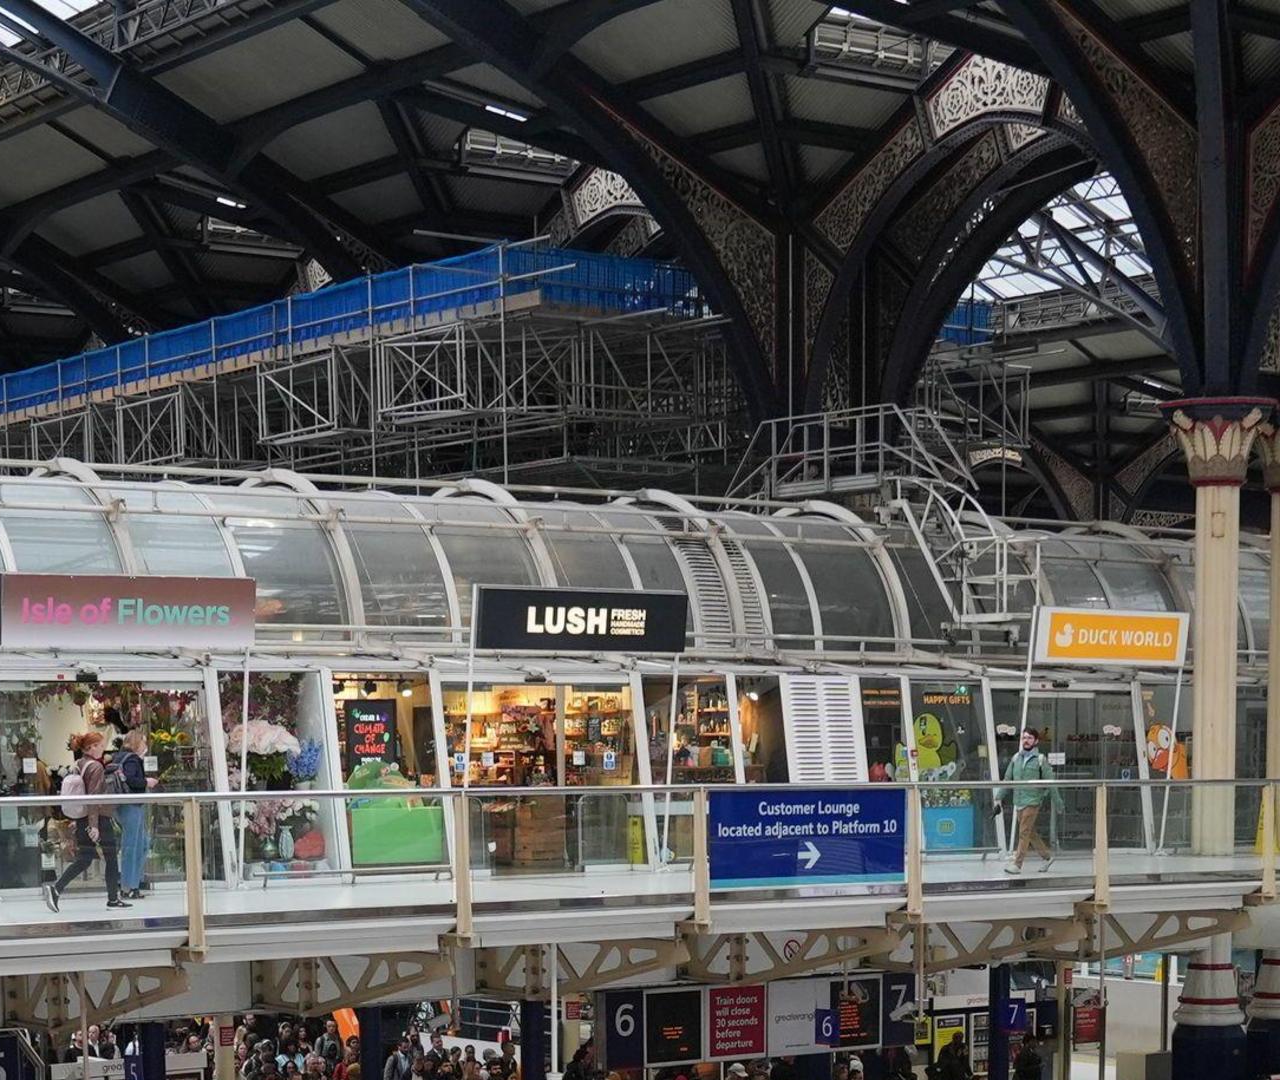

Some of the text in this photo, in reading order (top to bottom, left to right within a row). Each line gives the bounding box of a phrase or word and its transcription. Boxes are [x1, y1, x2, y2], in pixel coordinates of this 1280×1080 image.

[21, 597, 231, 627] Isle of Flowers
[527, 605, 608, 635] LUSH
[611, 608, 647, 620] FRESH
[1078, 626, 1172, 649] DUCK WORLD
[923, 695, 971, 705] HAPPY GIFTS
[354, 743, 386, 754] CHANGE
[758, 801, 860, 817] Customer Lounge
[718, 819, 897, 839] located adjacent to Platform 10
[715, 995, 758, 1005] Train doors
[891, 984, 908, 1008] 7
[715, 1006, 751, 1016] will close
[1008, 1003, 1019, 1024] 7
[614, 1003, 635, 1037] 6
[716, 1017, 758, 1028] 30 seconds
[822, 1015, 833, 1037] 6
[715, 1029, 742, 1039] before
[715, 1040, 754, 1050] departure
